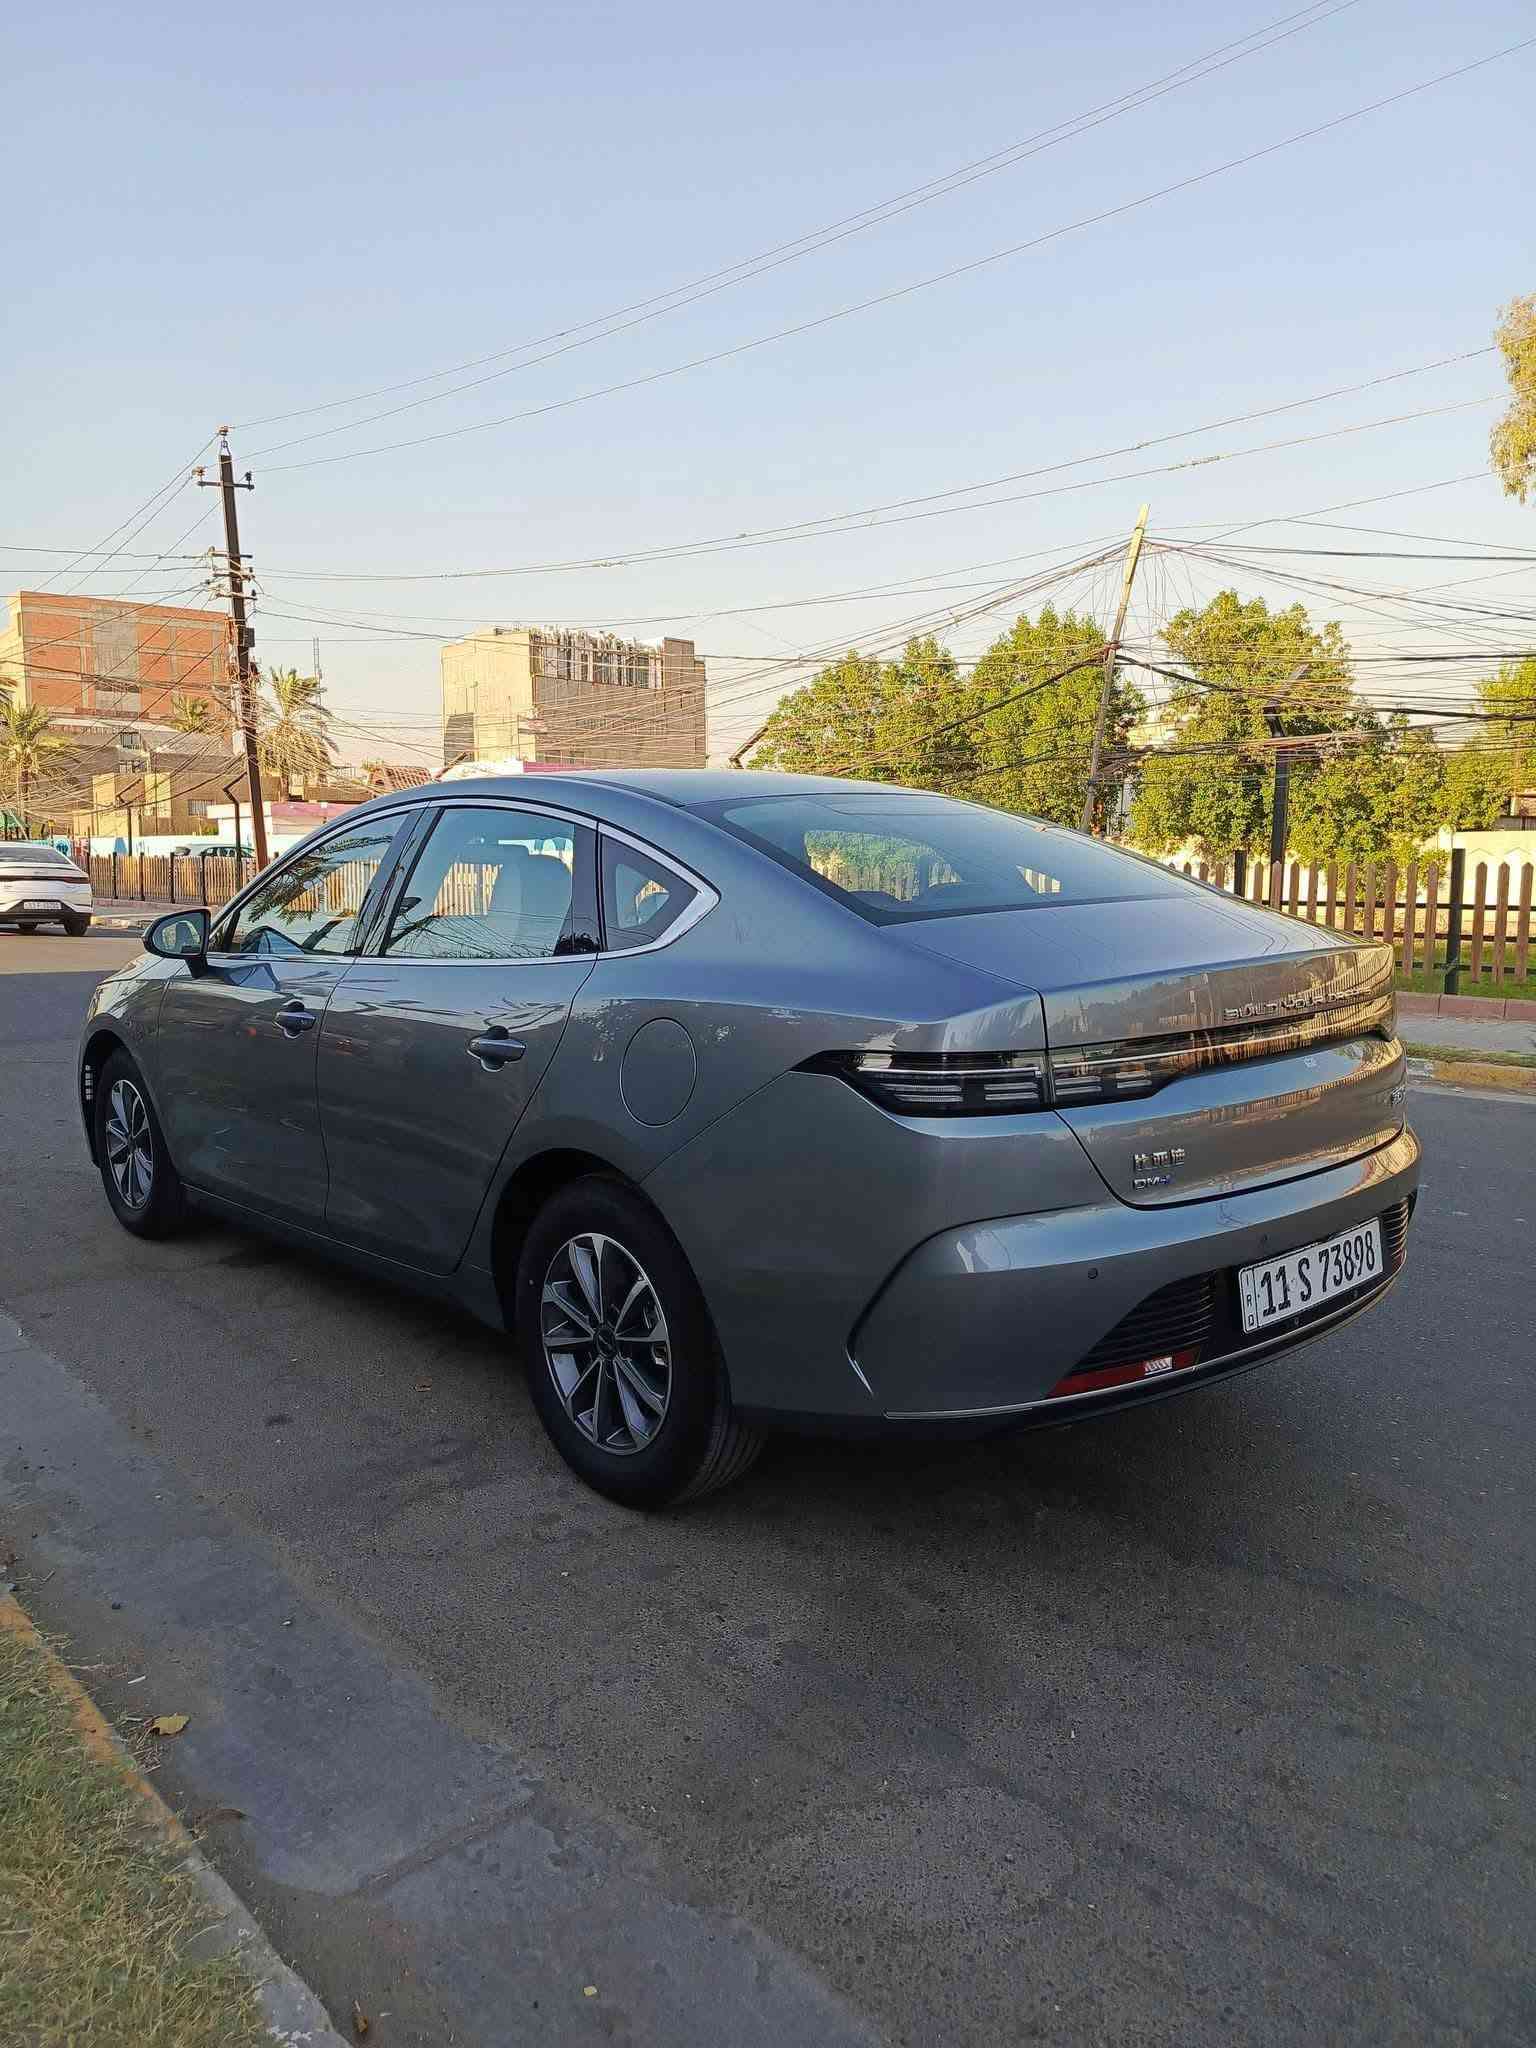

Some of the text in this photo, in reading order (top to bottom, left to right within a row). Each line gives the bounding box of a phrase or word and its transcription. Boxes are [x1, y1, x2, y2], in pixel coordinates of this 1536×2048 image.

[1260, 1230, 1376, 1317] 11 S 73898
